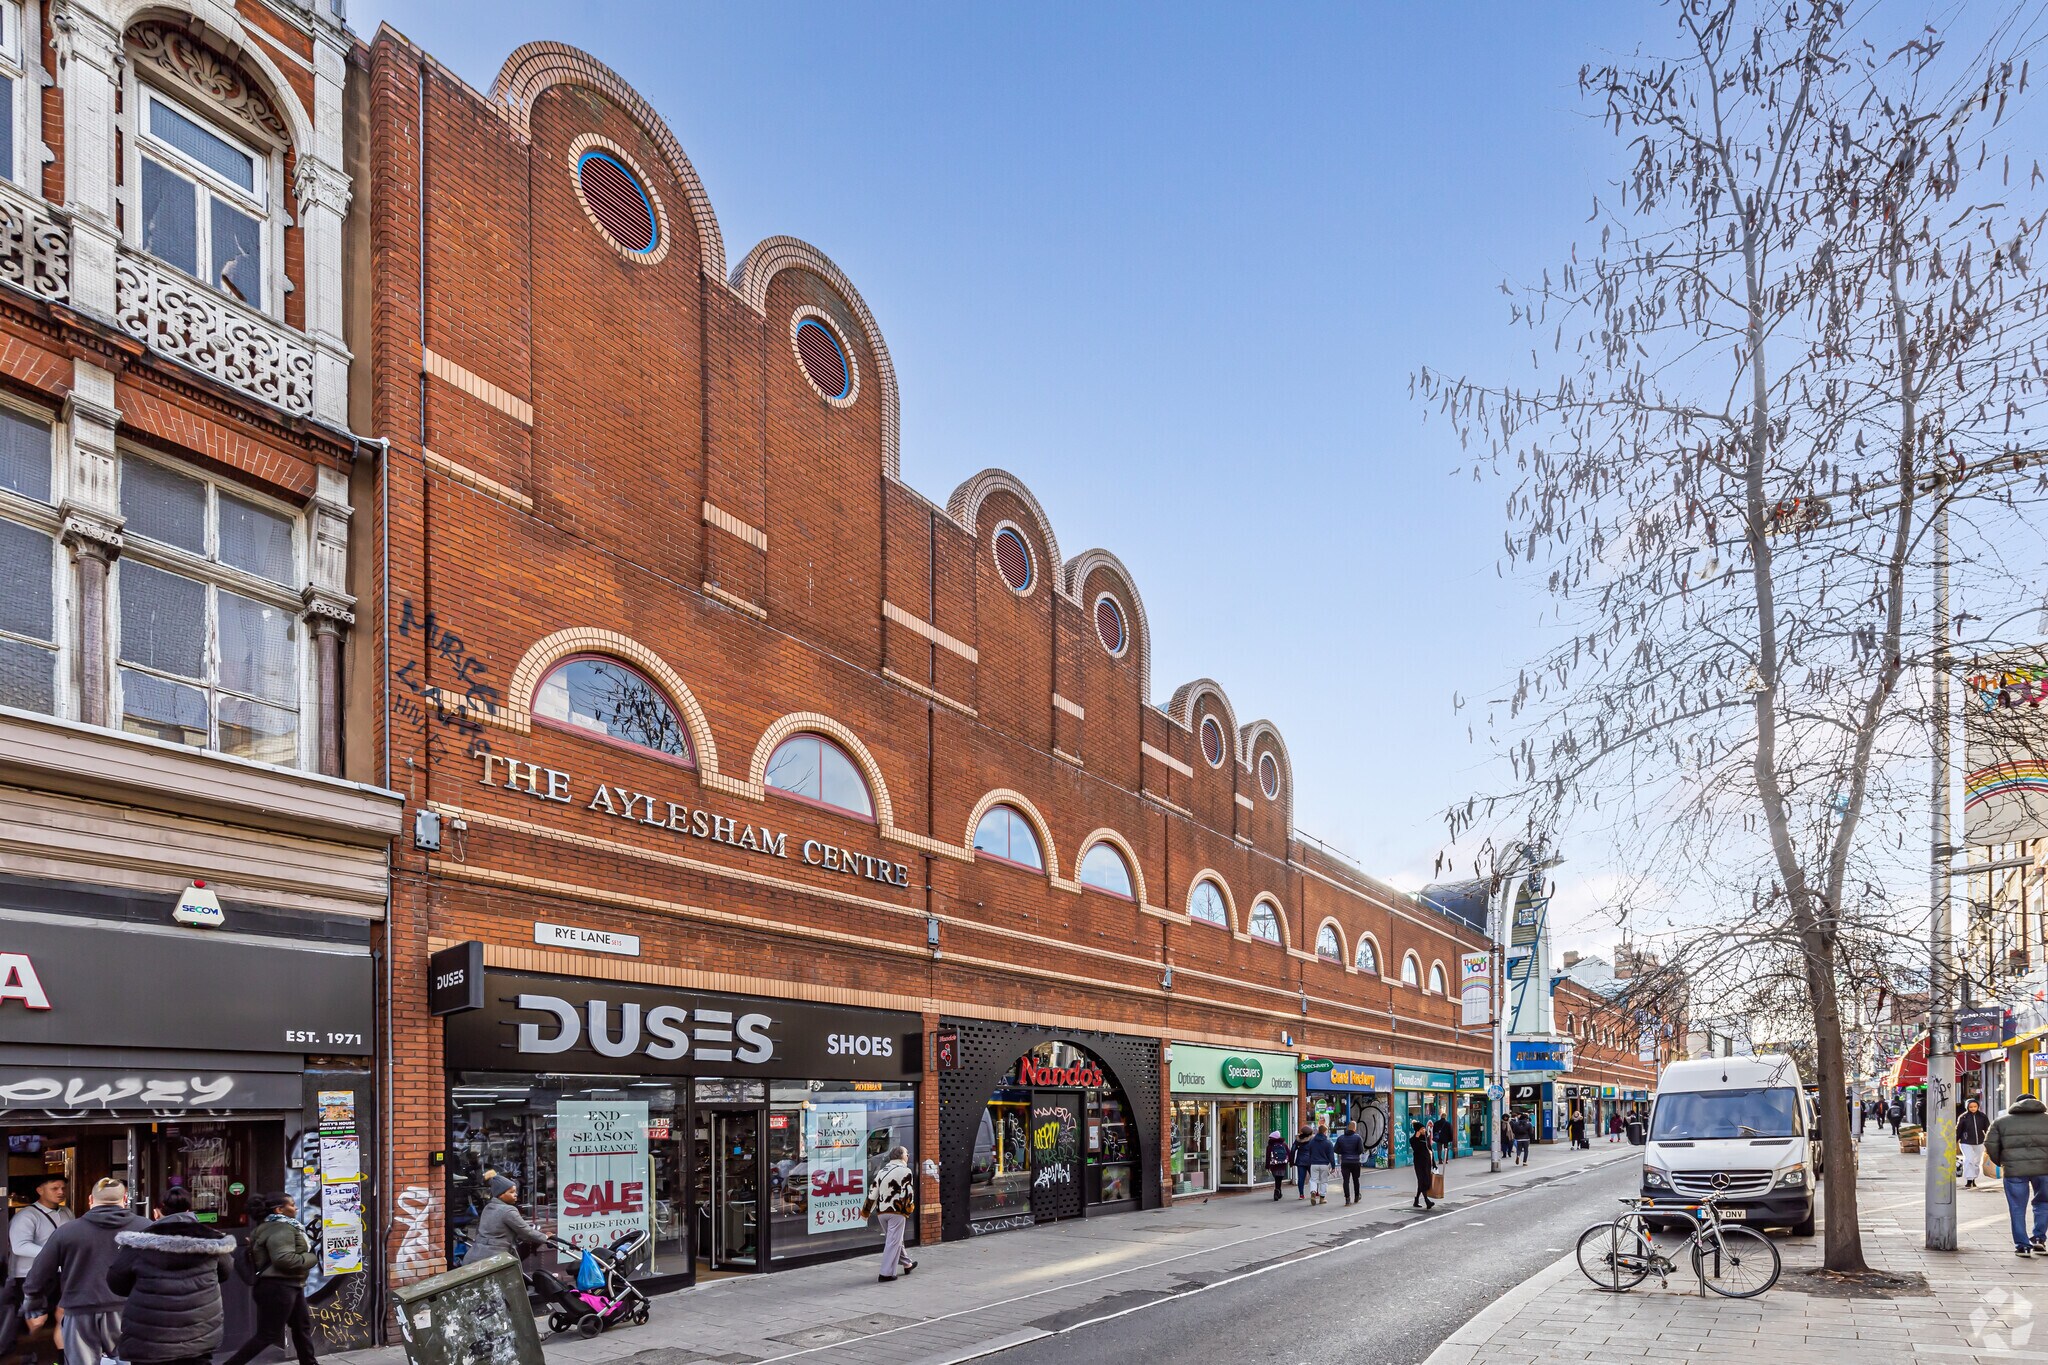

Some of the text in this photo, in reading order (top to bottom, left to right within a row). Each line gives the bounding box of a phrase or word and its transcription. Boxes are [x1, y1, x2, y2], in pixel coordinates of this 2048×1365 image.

[473, 750, 909, 888] THE AYLESHAM CENTRE
[182, 904, 219, 916] SECOM
[555, 927, 576, 940] RYE
[581, 931, 611, 945] LANE
[1463, 956, 1487, 966] THANK
[1466, 962, 1487, 974] YOU
[437, 968, 464, 990] DUSES
[518, 993, 893, 1064] DUSES SHOES
[286, 1030, 362, 1045] EST. 1971
[1019, 1056, 1103, 1087] Nando's
[1228, 1064, 1261, 1079] Specsavers
[1301, 1062, 1330, 1070] Specsavers
[1177, 1071, 1206, 1086] Opticians
[1271, 1077, 1293, 1090] Opticians
[1331, 1069, 1376, 1088] Card Factory
[1398, 1073, 1423, 1086] Poundland
[1516, 1087, 1533, 1098] JD
[588, 1110, 620, 1120] END
[827, 1112, 848, 1120] END
[594, 1121, 615, 1131] OF
[573, 1131, 634, 1142] SEASON
[817, 1128, 858, 1138] SEASON
[569, 1143, 638, 1153] CLEARANCE
[811, 1167, 864, 1198] SALE
[563, 1180, 644, 1217] SALE
[814, 1198, 861, 1208] SHOES FROM
[815, 1206, 861, 1226] £9.99
[1725, 1210, 1743, 1218] ONV
[568, 1217, 640, 1231] SHOES FROM
